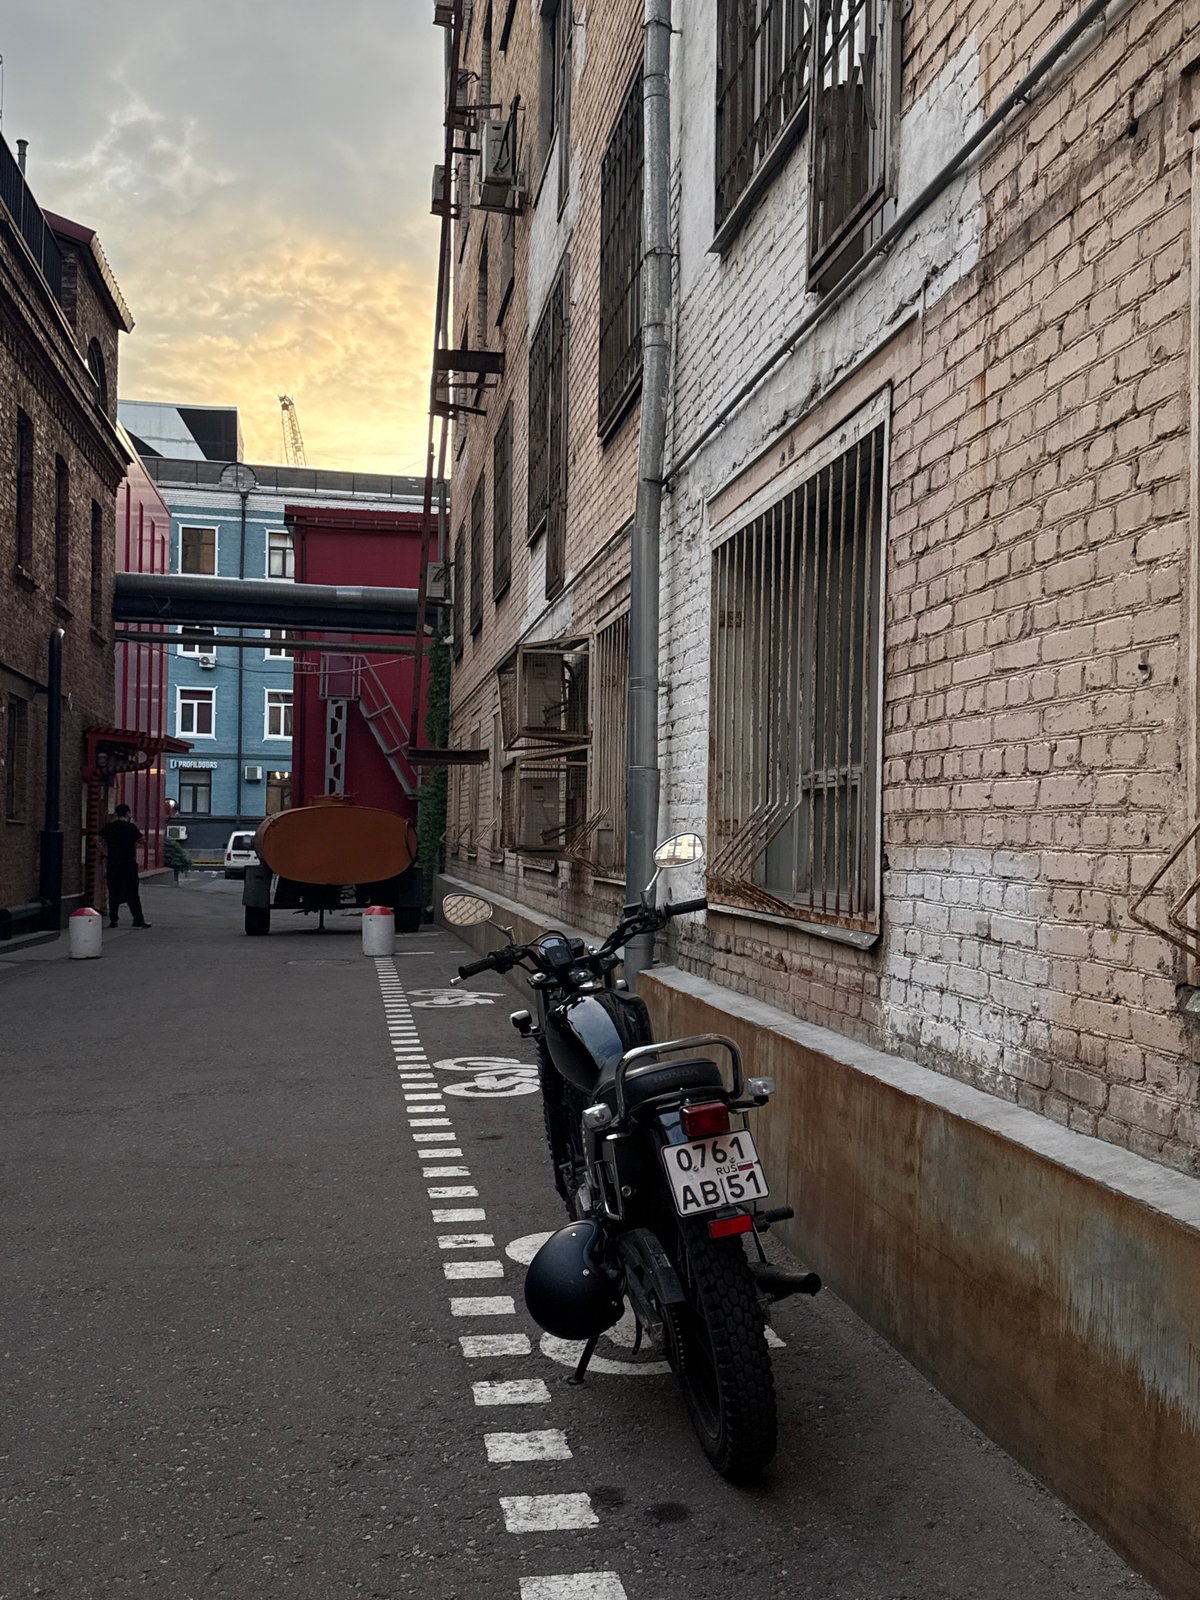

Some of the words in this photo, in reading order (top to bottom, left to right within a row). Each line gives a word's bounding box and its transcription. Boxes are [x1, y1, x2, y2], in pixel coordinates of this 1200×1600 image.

[178, 760, 218, 769] PROFILDOORS
[676, 1136, 744, 1172] 0761
[716, 1164, 738, 1176] RUS
[682, 1180, 720, 1210] AB
[727, 1170, 761, 1199] 51
